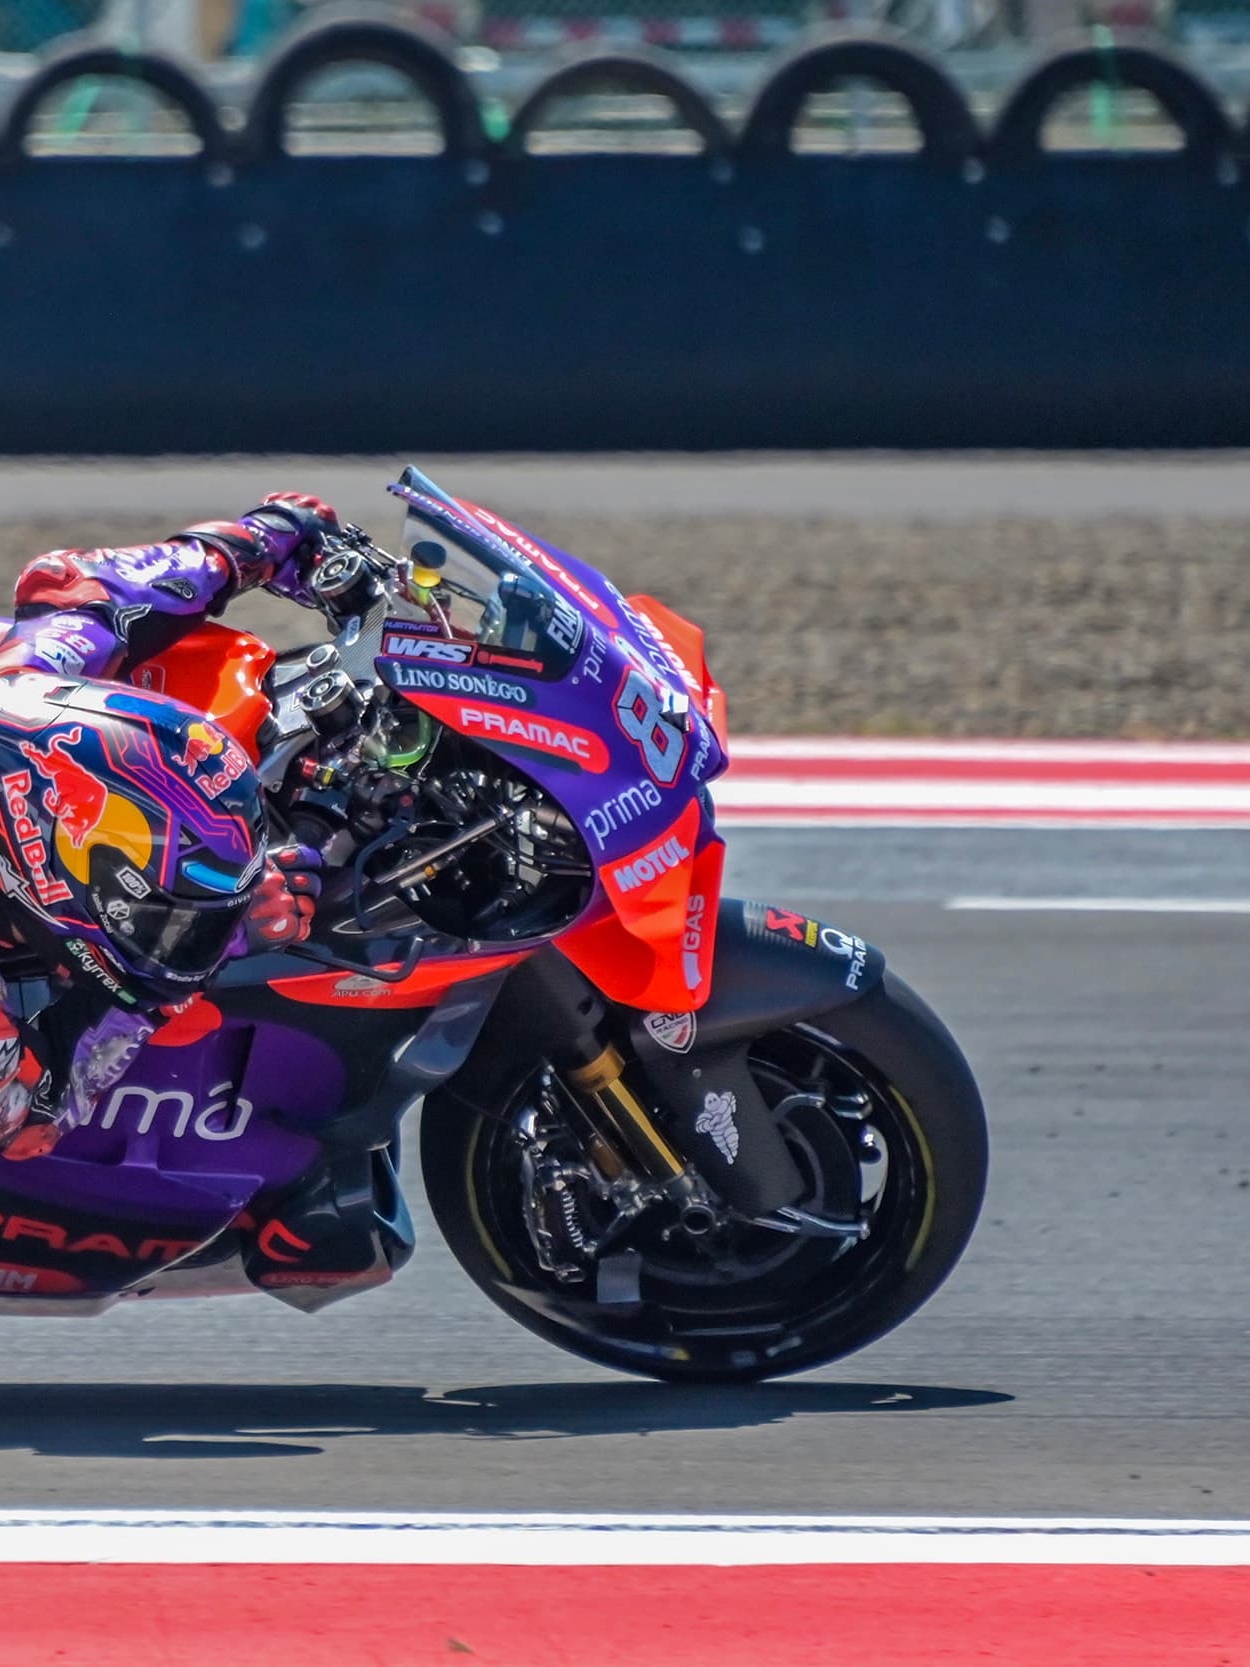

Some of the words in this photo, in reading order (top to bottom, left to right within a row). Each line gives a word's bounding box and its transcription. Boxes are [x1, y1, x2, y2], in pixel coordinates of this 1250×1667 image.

[387, 637, 472, 662] WRS
[396, 667, 444, 688] LINO
[461, 708, 590, 759] PRAMAC
[584, 779, 662, 850] prima
[121, 872, 147, 894] 100%
[613, 837, 690, 893] MOTUL
